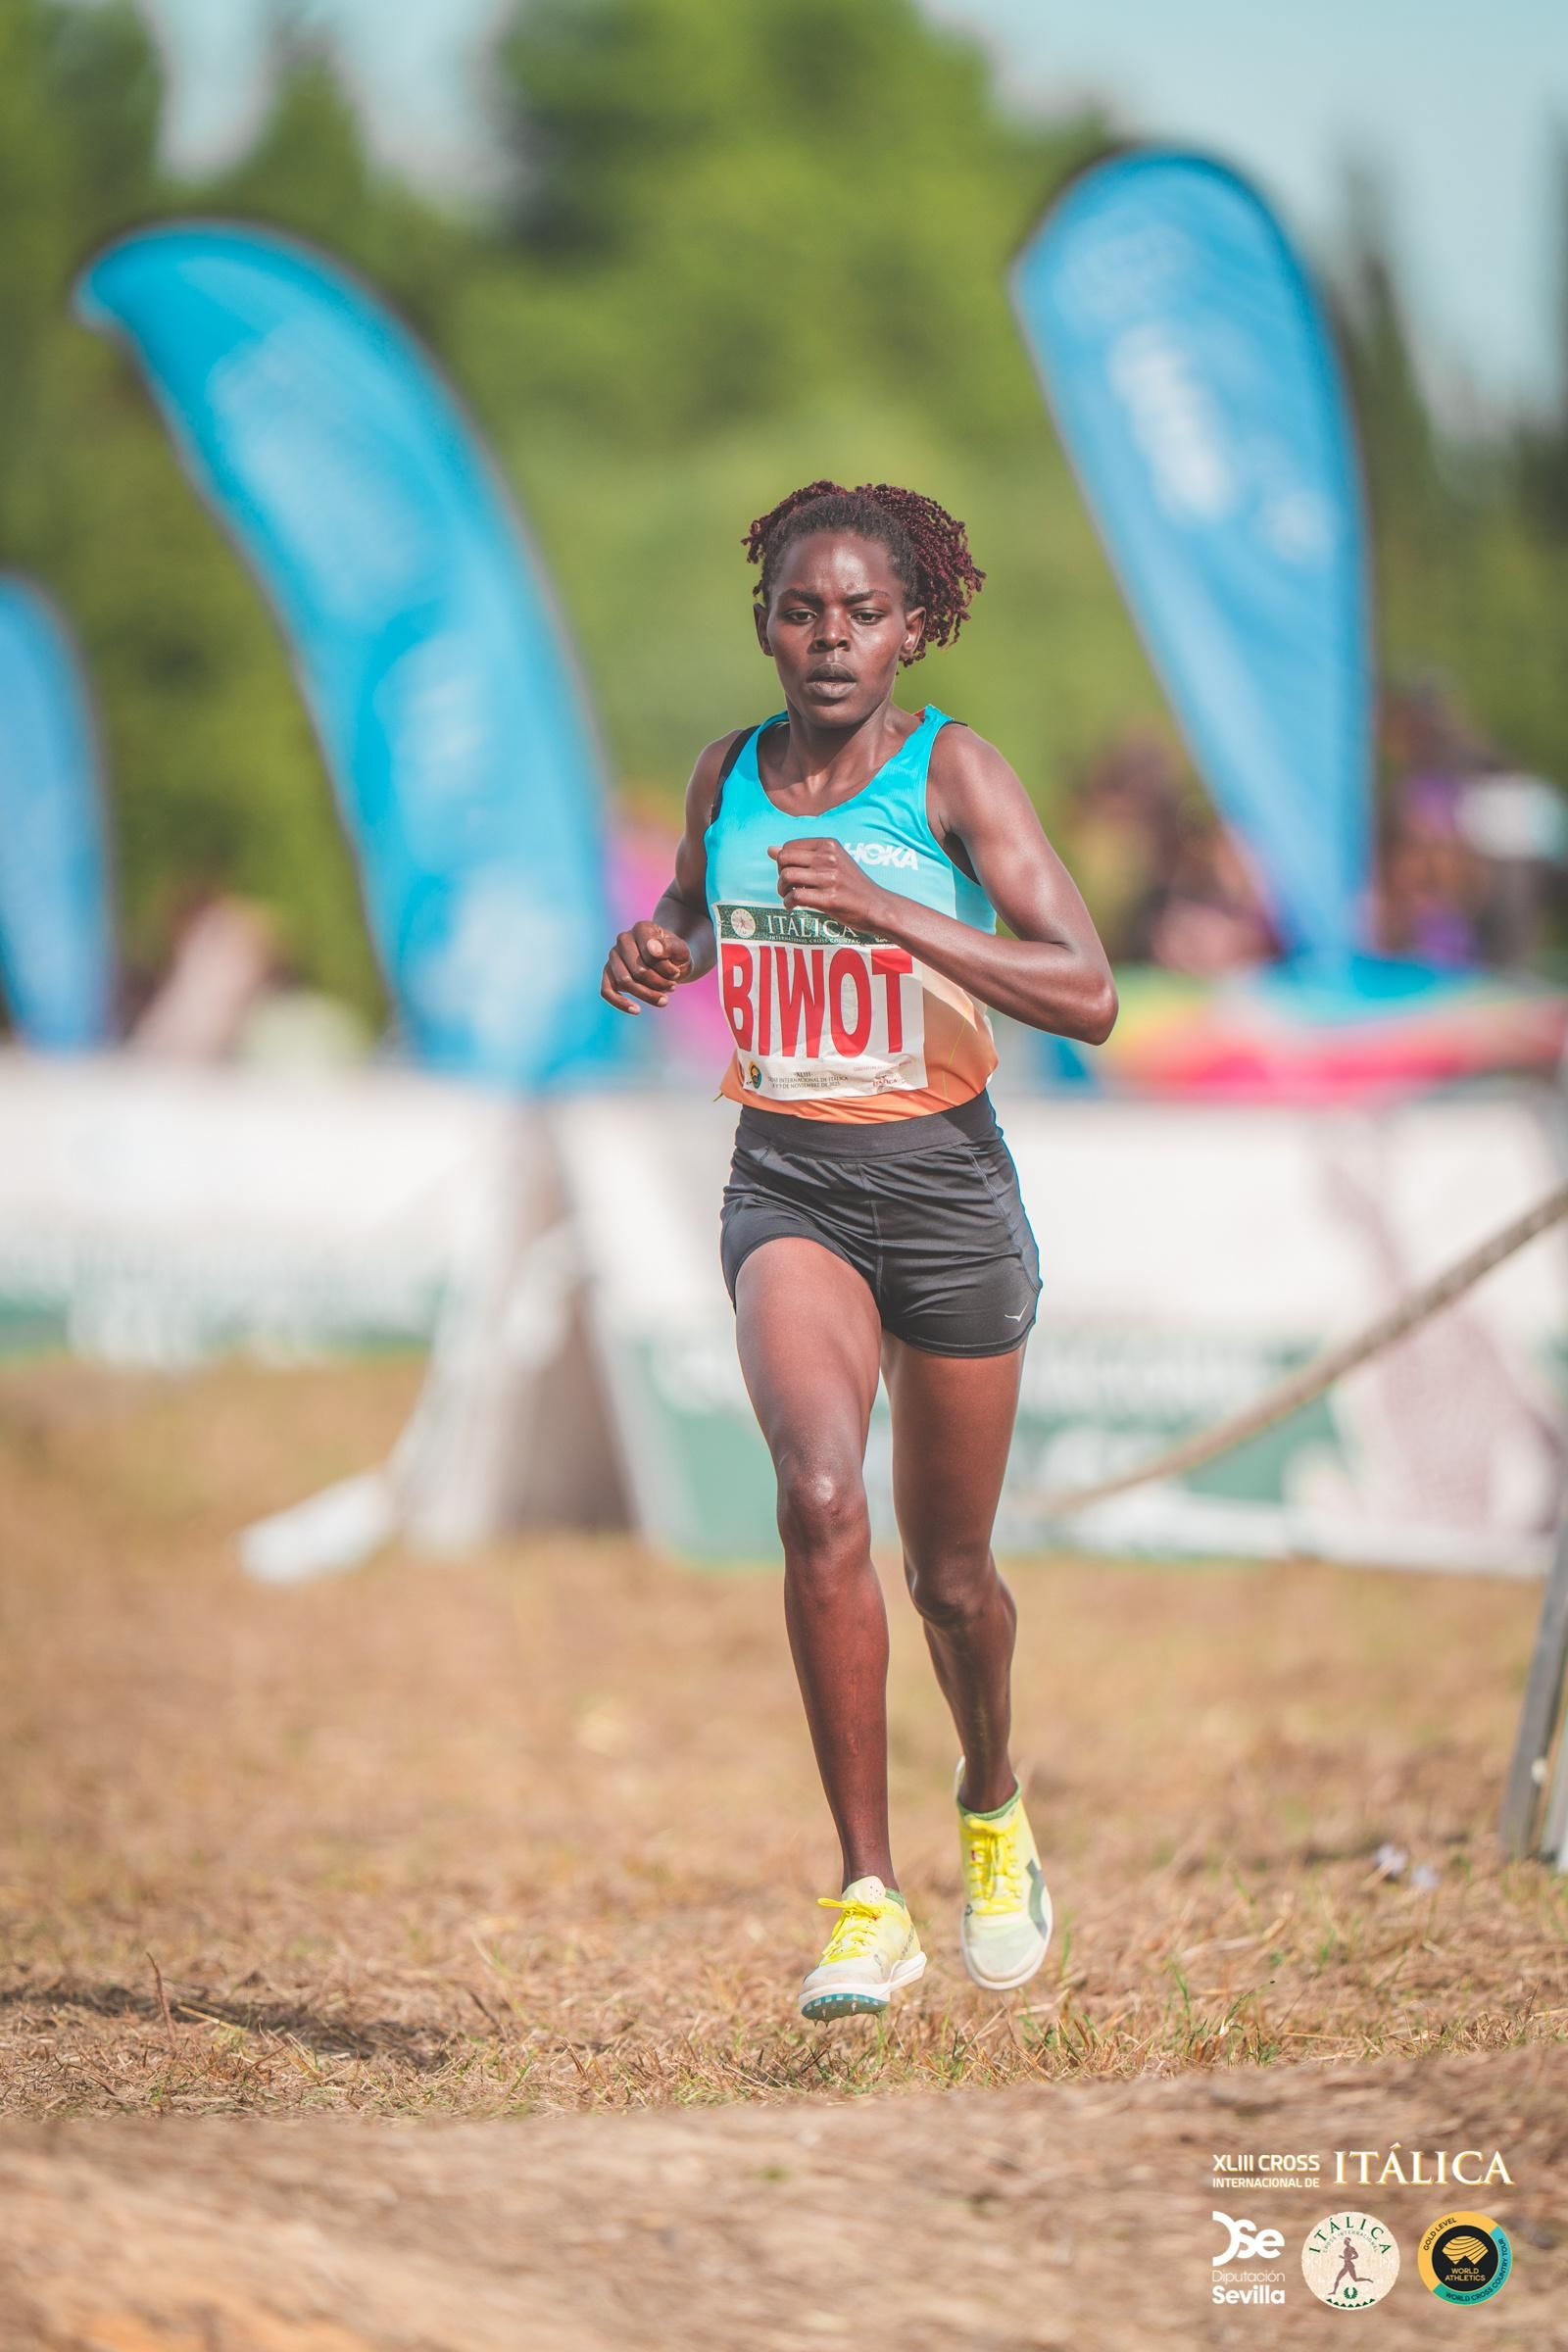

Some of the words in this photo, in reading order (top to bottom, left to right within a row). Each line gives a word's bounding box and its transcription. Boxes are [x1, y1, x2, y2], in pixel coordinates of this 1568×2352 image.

[843, 842, 919, 870] HOKA
[766, 911, 858, 937] ITÁLICA
[720, 942, 912, 1058] BIWOT
